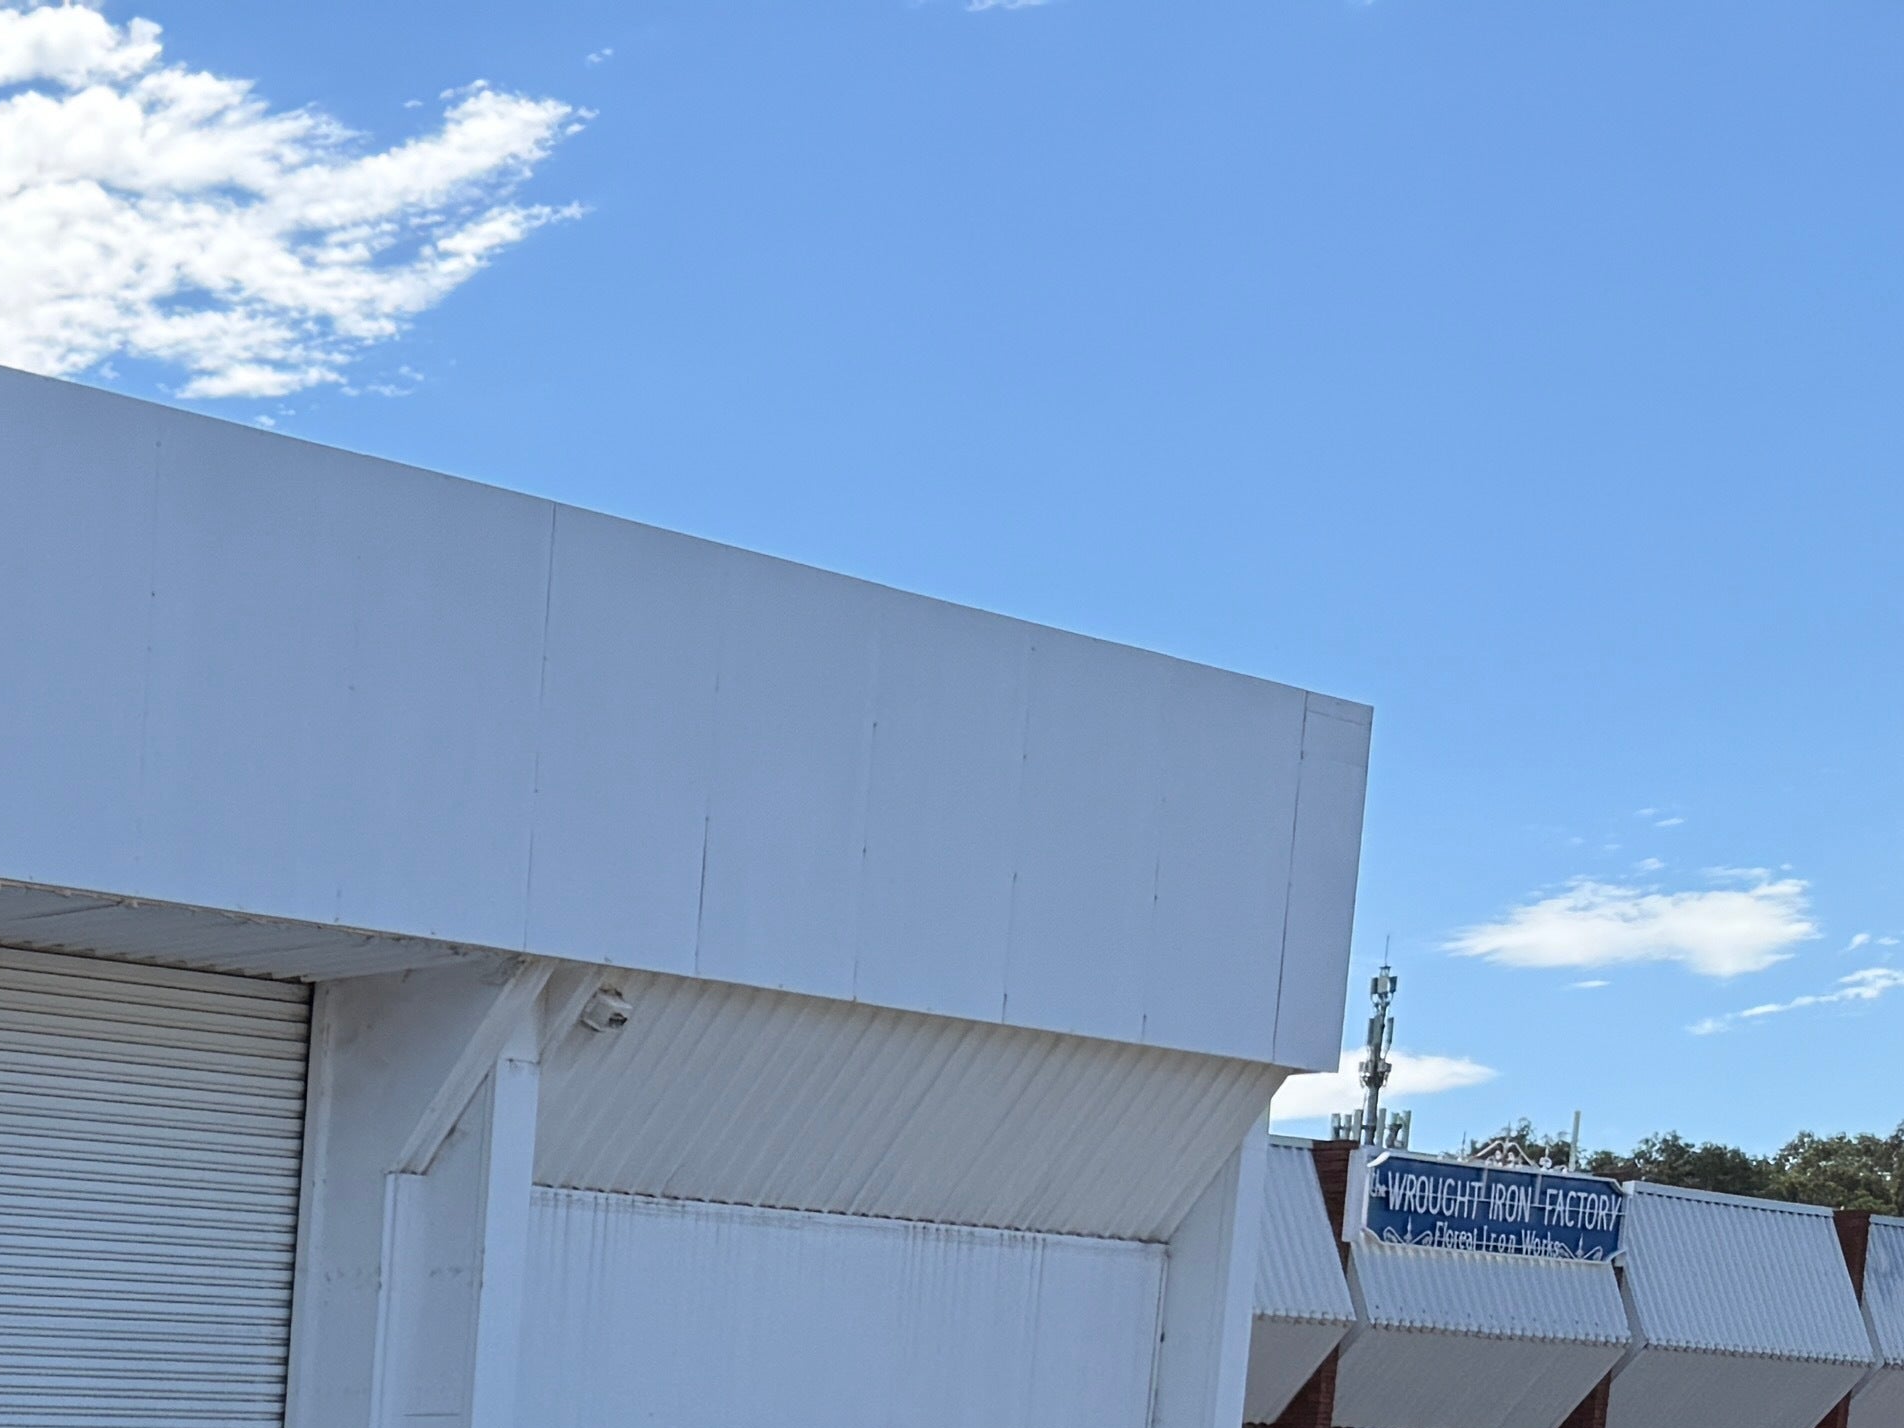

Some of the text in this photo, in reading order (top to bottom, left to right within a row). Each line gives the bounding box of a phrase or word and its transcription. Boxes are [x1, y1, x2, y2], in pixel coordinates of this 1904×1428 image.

[1388, 1171, 1483, 1220] WROUGHT
[1489, 1183, 1532, 1222] IRON
[1544, 1188, 1622, 1231] FACTORY
